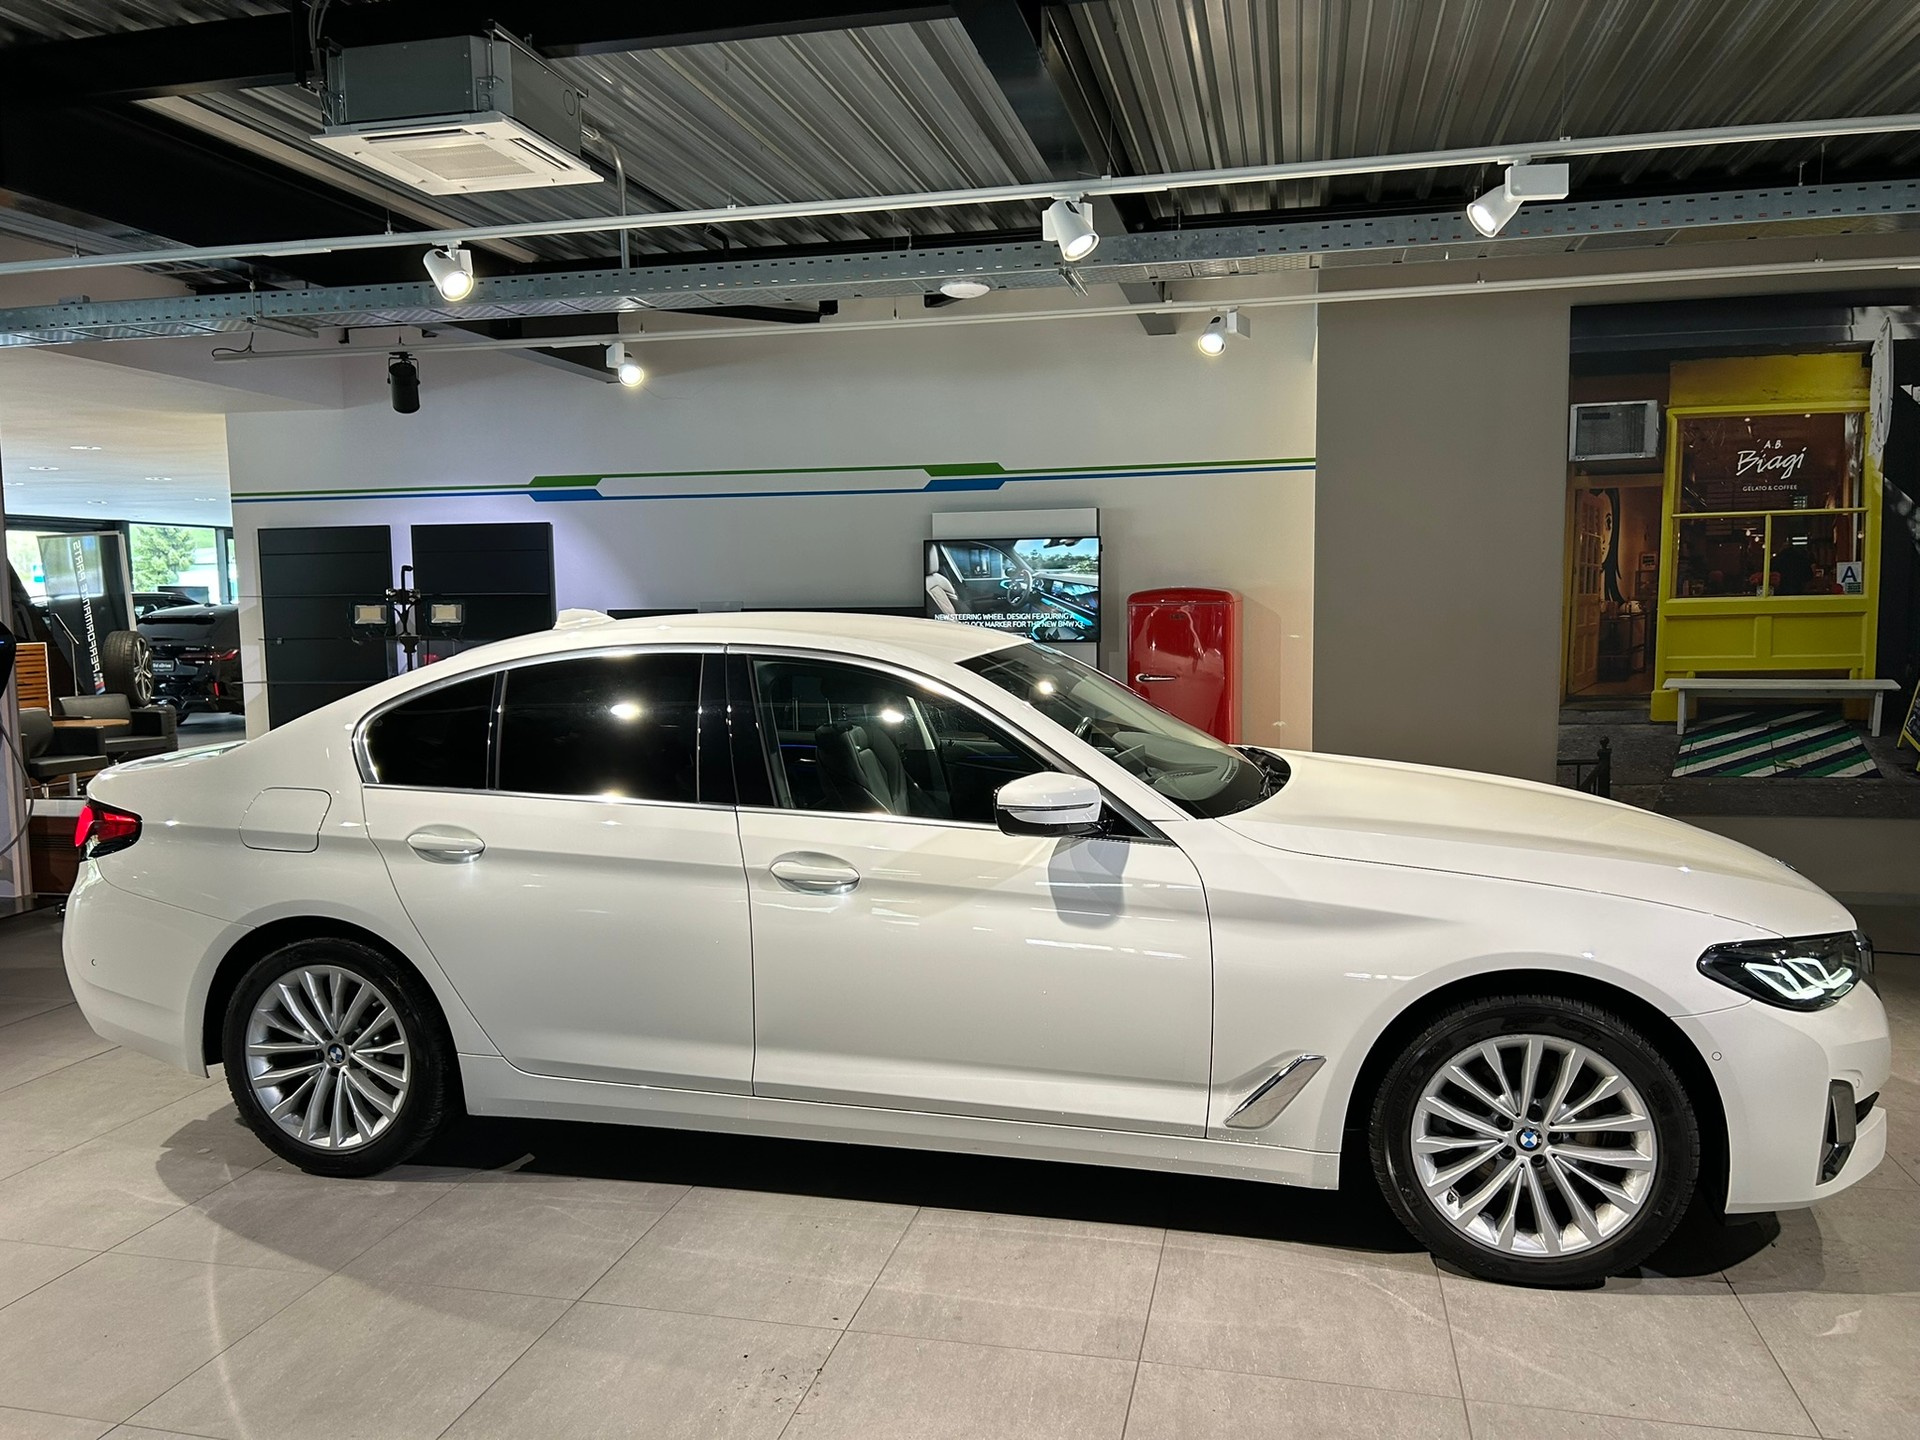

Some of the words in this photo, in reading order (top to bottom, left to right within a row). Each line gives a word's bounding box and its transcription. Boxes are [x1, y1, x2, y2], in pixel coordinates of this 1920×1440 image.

[1736, 446, 1807, 480] Biagi
[1841, 566, 1857, 583] A
[934, 613, 949, 621] NEW
[1006, 612, 1031, 620] DESIGN
[1032, 612, 1069, 620] FEATURING
[1012, 620, 1027, 628] FOR
[1027, 620, 1042, 628] THE
[1042, 620, 1057, 628] NEW
[1057, 620, 1074, 628] BMW
